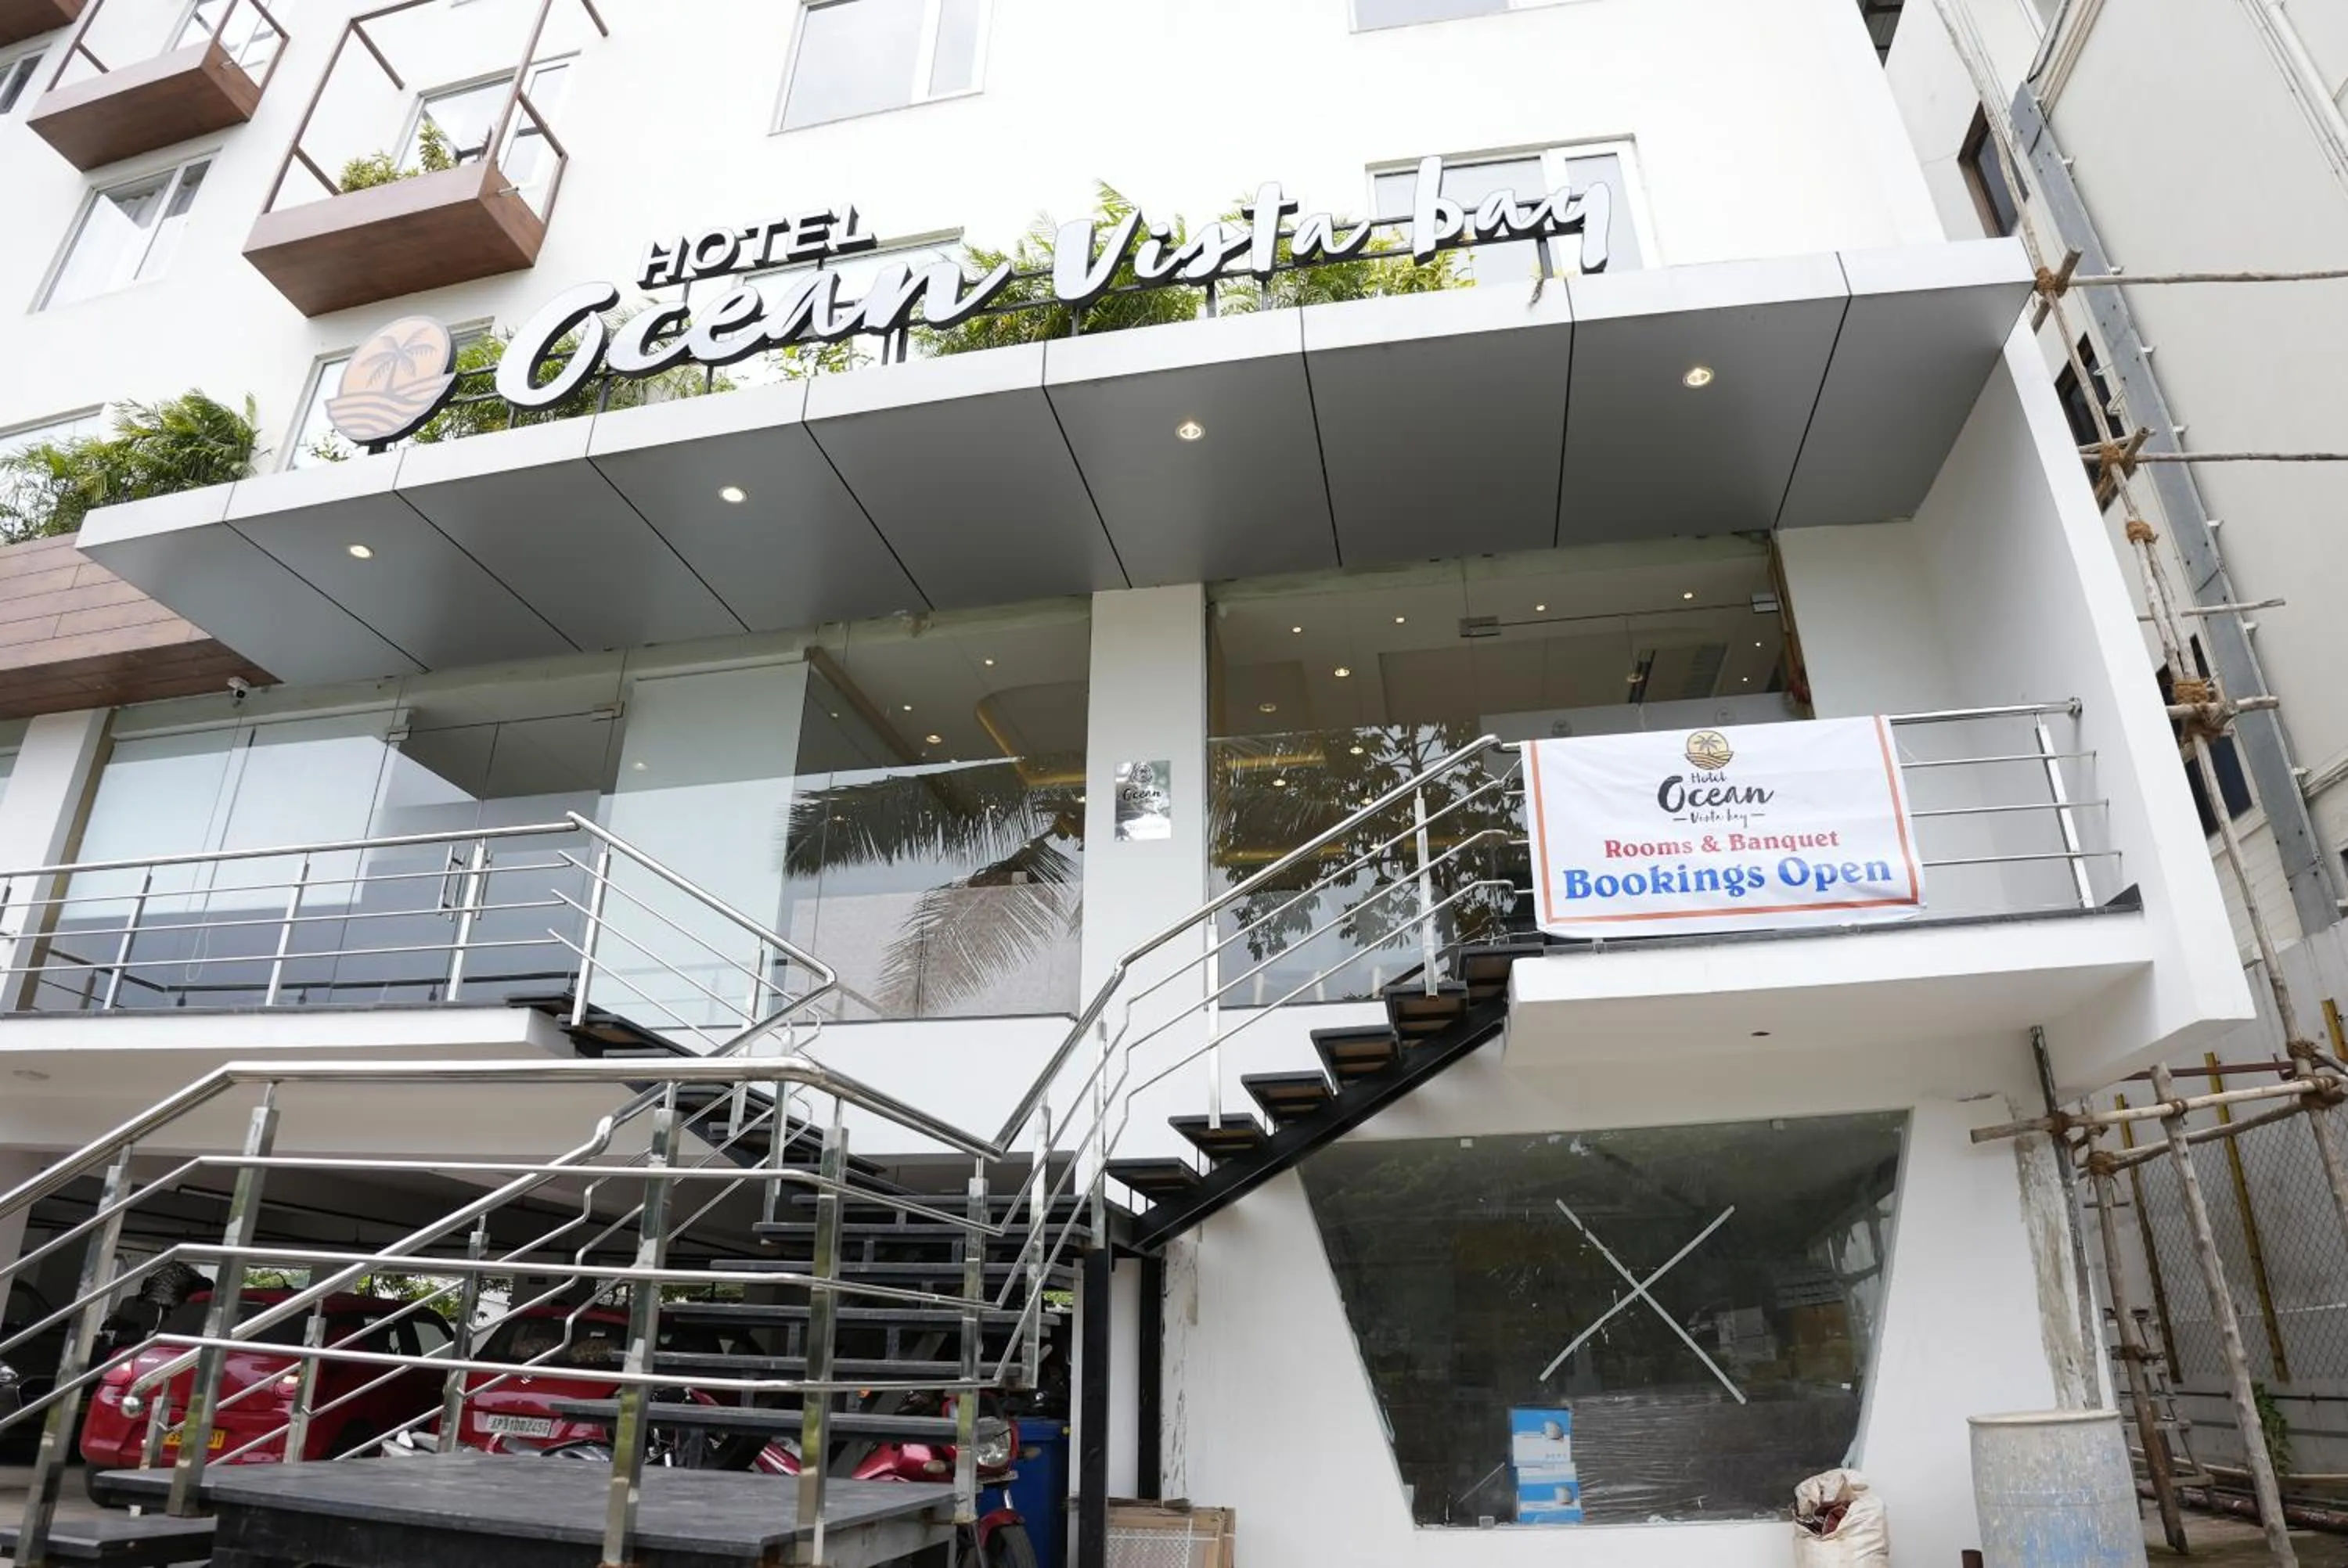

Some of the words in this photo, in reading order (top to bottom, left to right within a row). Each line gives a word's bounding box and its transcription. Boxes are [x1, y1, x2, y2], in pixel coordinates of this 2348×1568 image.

[638, 203, 875, 286] HOTEL
[495, 257, 1011, 410] Ocean
[1053, 182, 1372, 307] Vista
[1412, 156, 1612, 275] bay
[1658, 775, 1774, 813] Ocean
[1691, 771, 1727, 783] Hotel
[1604, 840, 1693, 858] Rooms
[1700, 835, 1721, 853] &
[1728, 831, 1840, 852] Banquet
[1563, 864, 1765, 899] Bookings
[1777, 857, 1892, 892] Open
